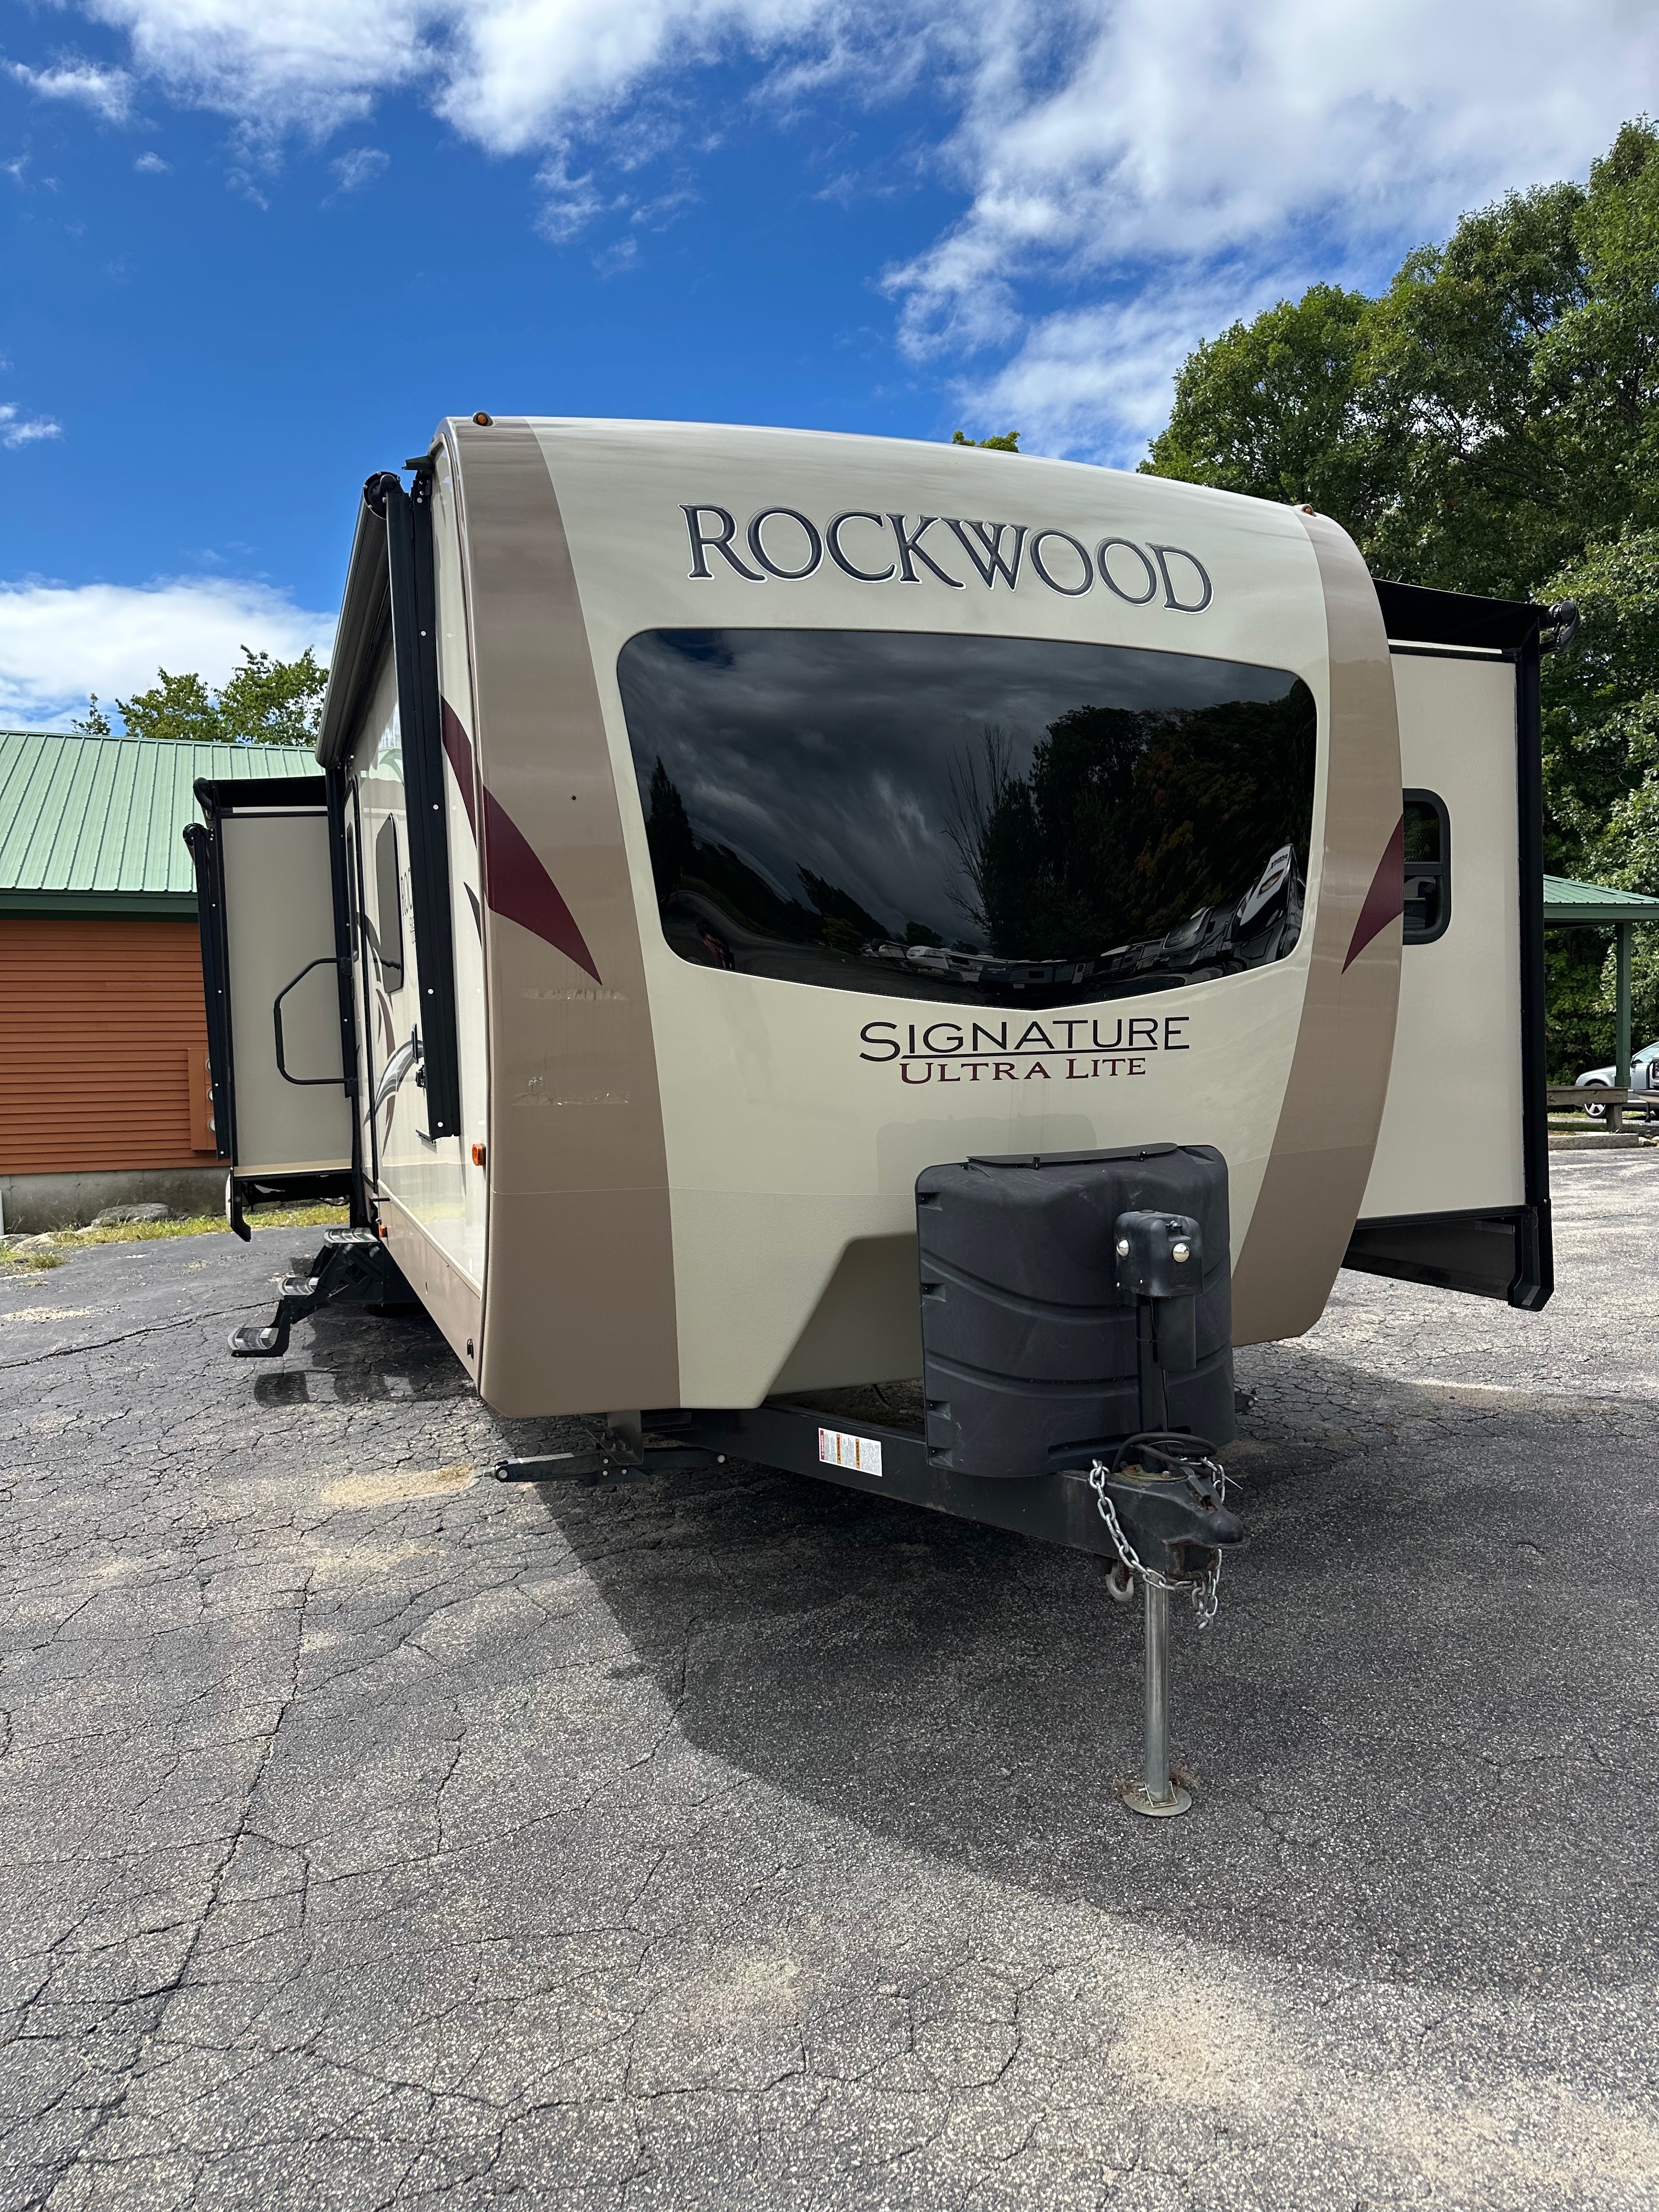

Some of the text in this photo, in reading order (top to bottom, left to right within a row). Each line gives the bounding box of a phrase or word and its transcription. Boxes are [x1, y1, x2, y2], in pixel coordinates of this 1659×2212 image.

[677, 503, 1214, 614] ROCKWOOD
[859, 1017, 1189, 1062] SIGNATURE
[899, 1058, 1146, 1084] ULTRA LITE
